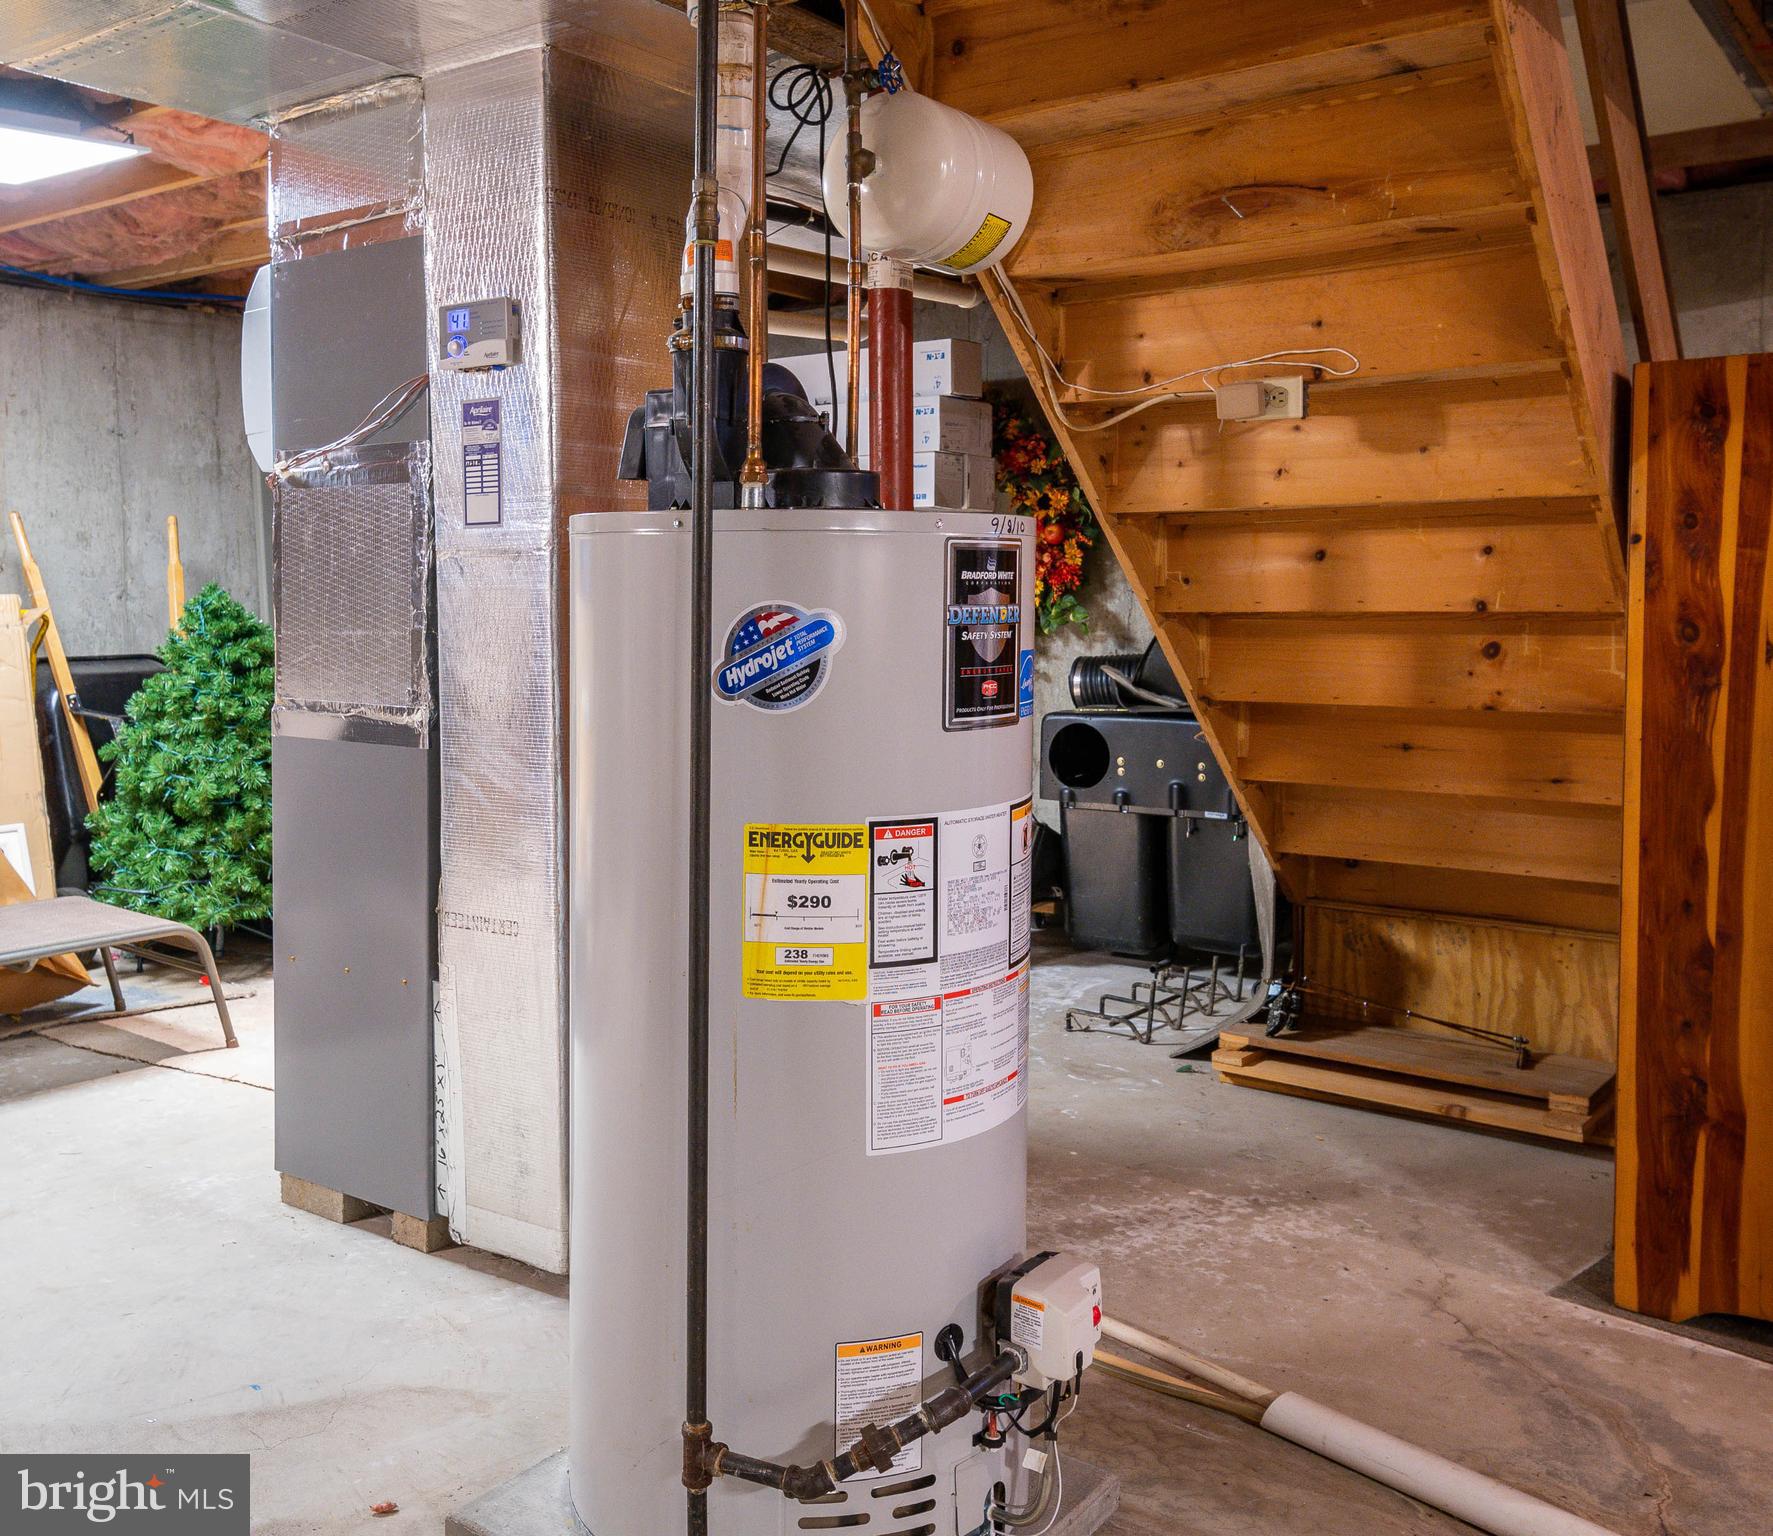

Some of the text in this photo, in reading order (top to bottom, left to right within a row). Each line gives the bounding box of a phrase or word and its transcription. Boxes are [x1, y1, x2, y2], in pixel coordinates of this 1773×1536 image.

[469, 406, 493, 416] Aprilaire
[961, 571, 1015, 580] BRADFORD WHITE
[949, 604, 1020, 626] DEFENDER
[961, 630, 1012, 641] SAFETY SYSTEM
[798, 639, 816, 653] SYSTEM
[726, 638, 795, 688] Hydrojet
[895, 828, 926, 837] DANGER
[787, 895, 832, 910] $290
[784, 949, 808, 959] 238
[866, 1341, 902, 1352] WARNING
